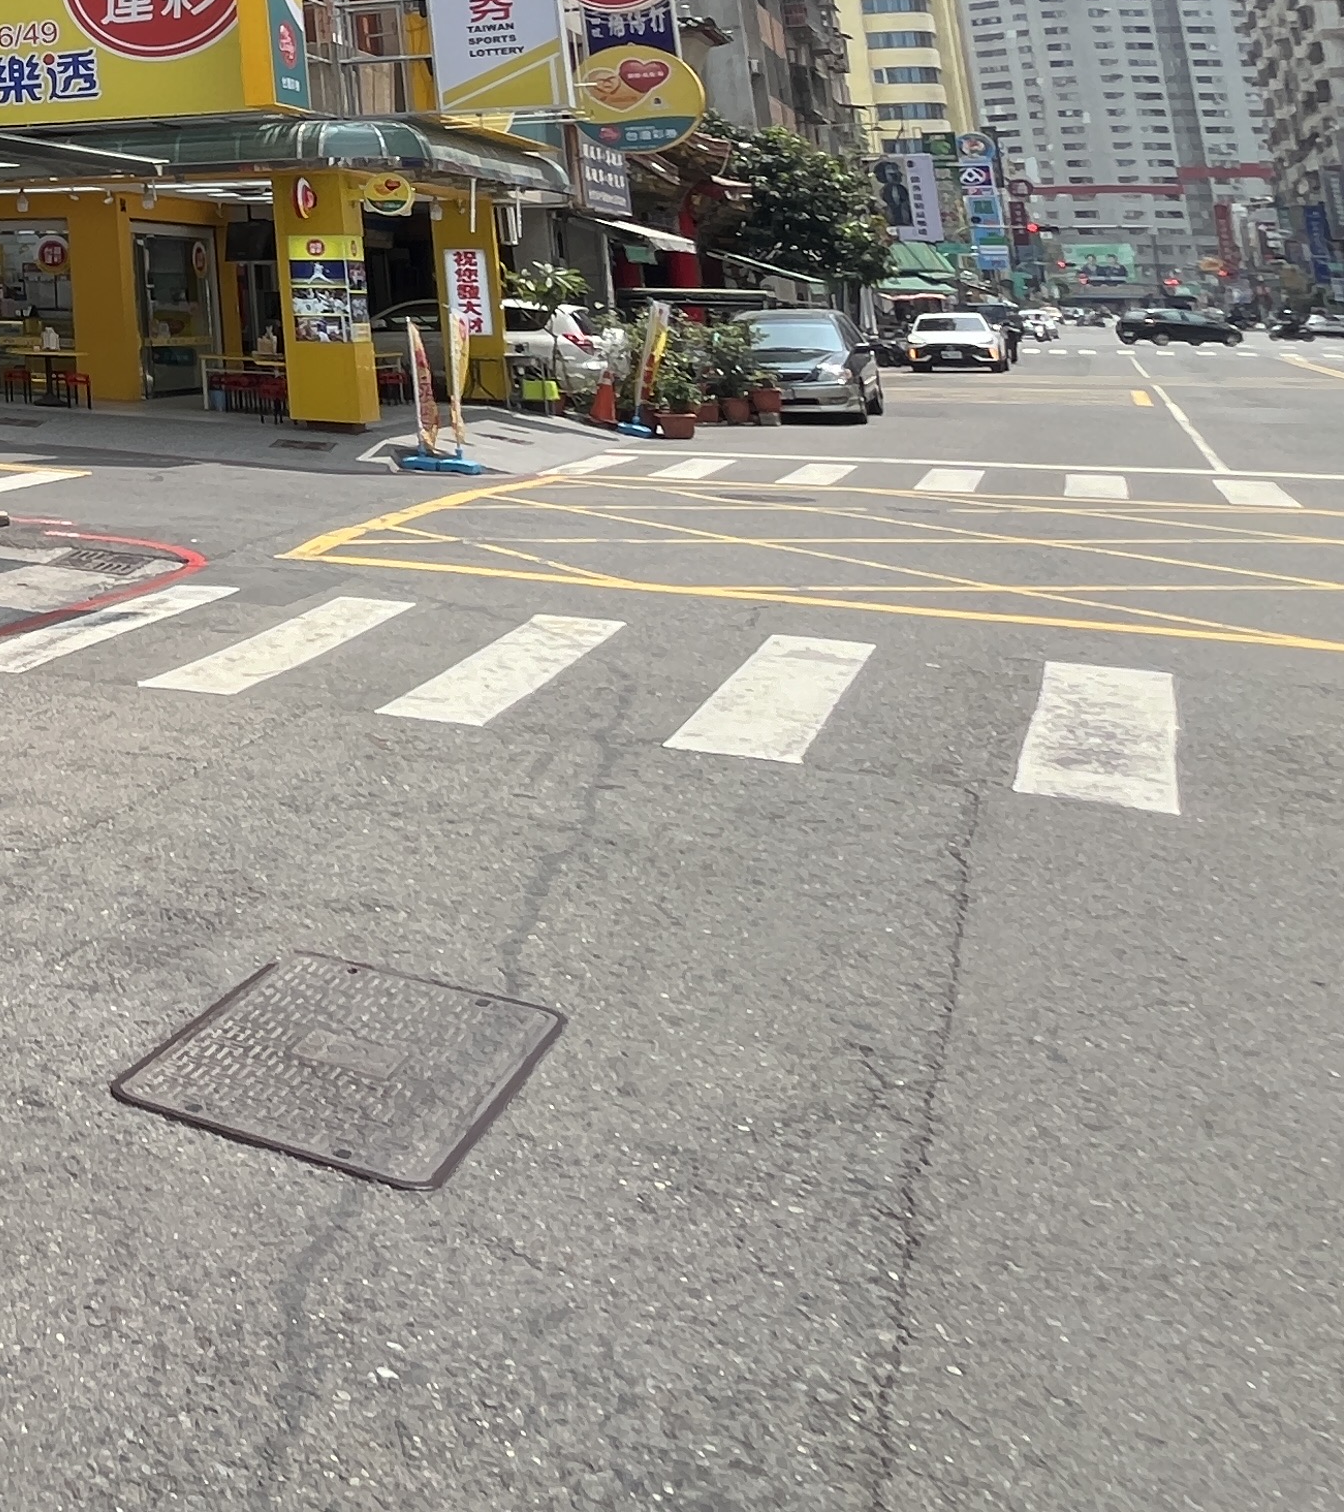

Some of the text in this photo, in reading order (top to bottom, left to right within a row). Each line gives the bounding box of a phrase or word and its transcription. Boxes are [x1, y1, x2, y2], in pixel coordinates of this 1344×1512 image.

[467, 23, 514, 33] TAIWAN
[468, 35, 516, 45] SPORTS
[469, 46, 524, 58] LOTTERY
